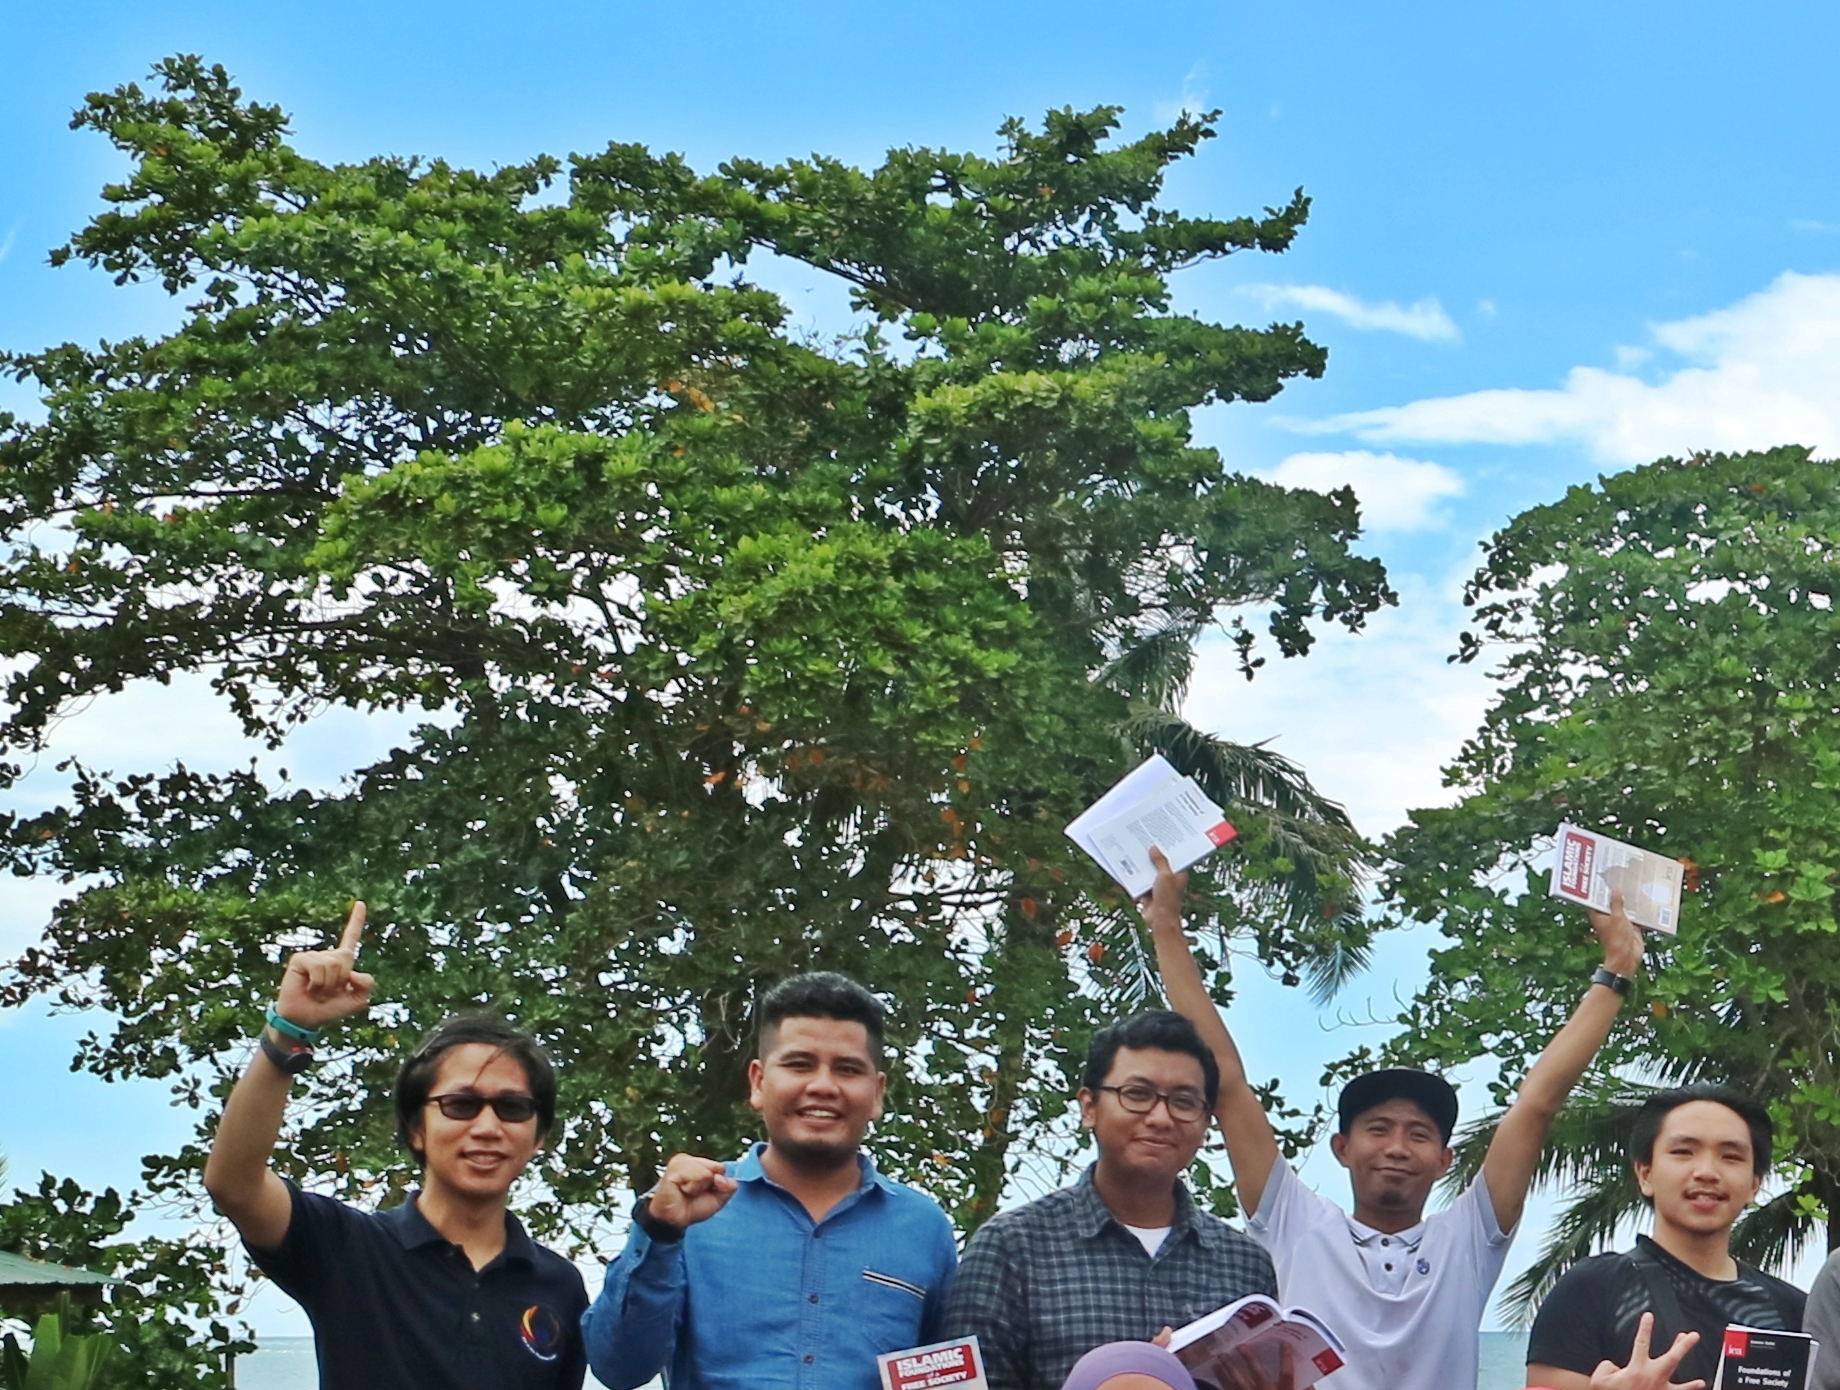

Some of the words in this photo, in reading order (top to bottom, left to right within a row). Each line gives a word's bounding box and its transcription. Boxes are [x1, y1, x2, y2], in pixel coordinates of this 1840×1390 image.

[1562, 838, 1577, 889] ISLAMIC
[896, 1347, 964, 1371] ISLAMIC
[927, 1371, 968, 1387] SOCIETY
[1737, 1365, 1781, 1377] Foundations
[1782, 1369, 1792, 1377] of
[1744, 1376, 1760, 1385] Free
[1762, 1375, 1789, 1388] Society
